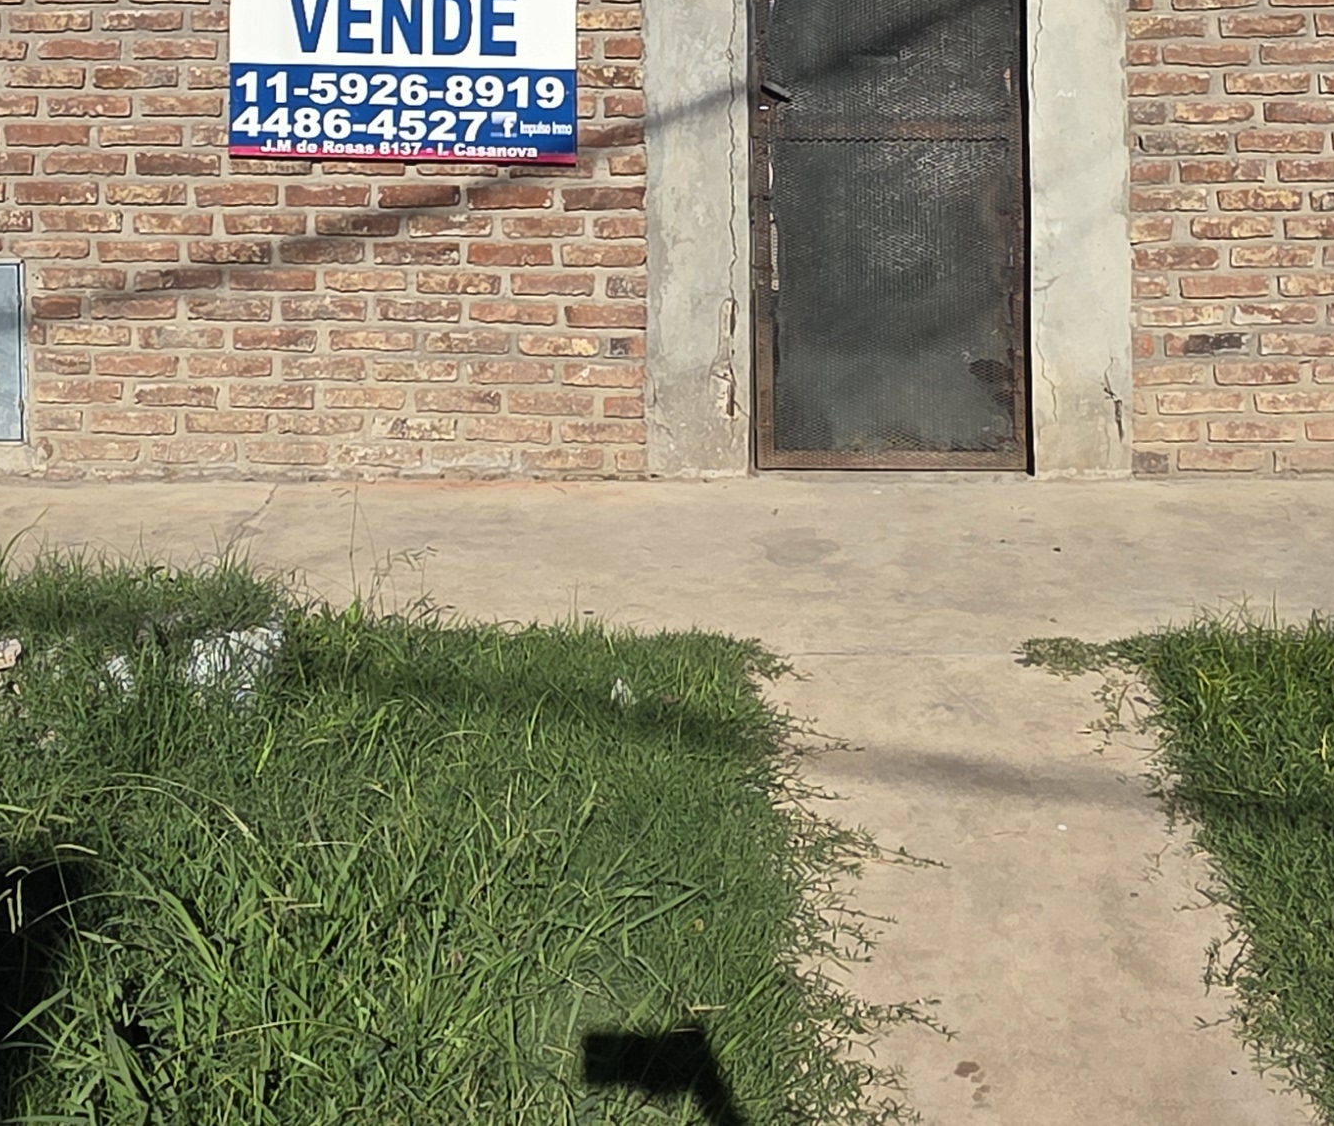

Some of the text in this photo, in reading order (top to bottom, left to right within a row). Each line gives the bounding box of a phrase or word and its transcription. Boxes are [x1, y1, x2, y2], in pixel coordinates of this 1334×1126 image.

[236, 71, 565, 109] 11-5926-8919
[232, 106, 488, 142] 4486-4527
[260, 139, 292, 153] J.M
[296, 140, 317, 153] de
[323, 140, 375, 155] Rosas
[379, 141, 422, 155] 8137
[453, 143, 538, 158] Casanova
